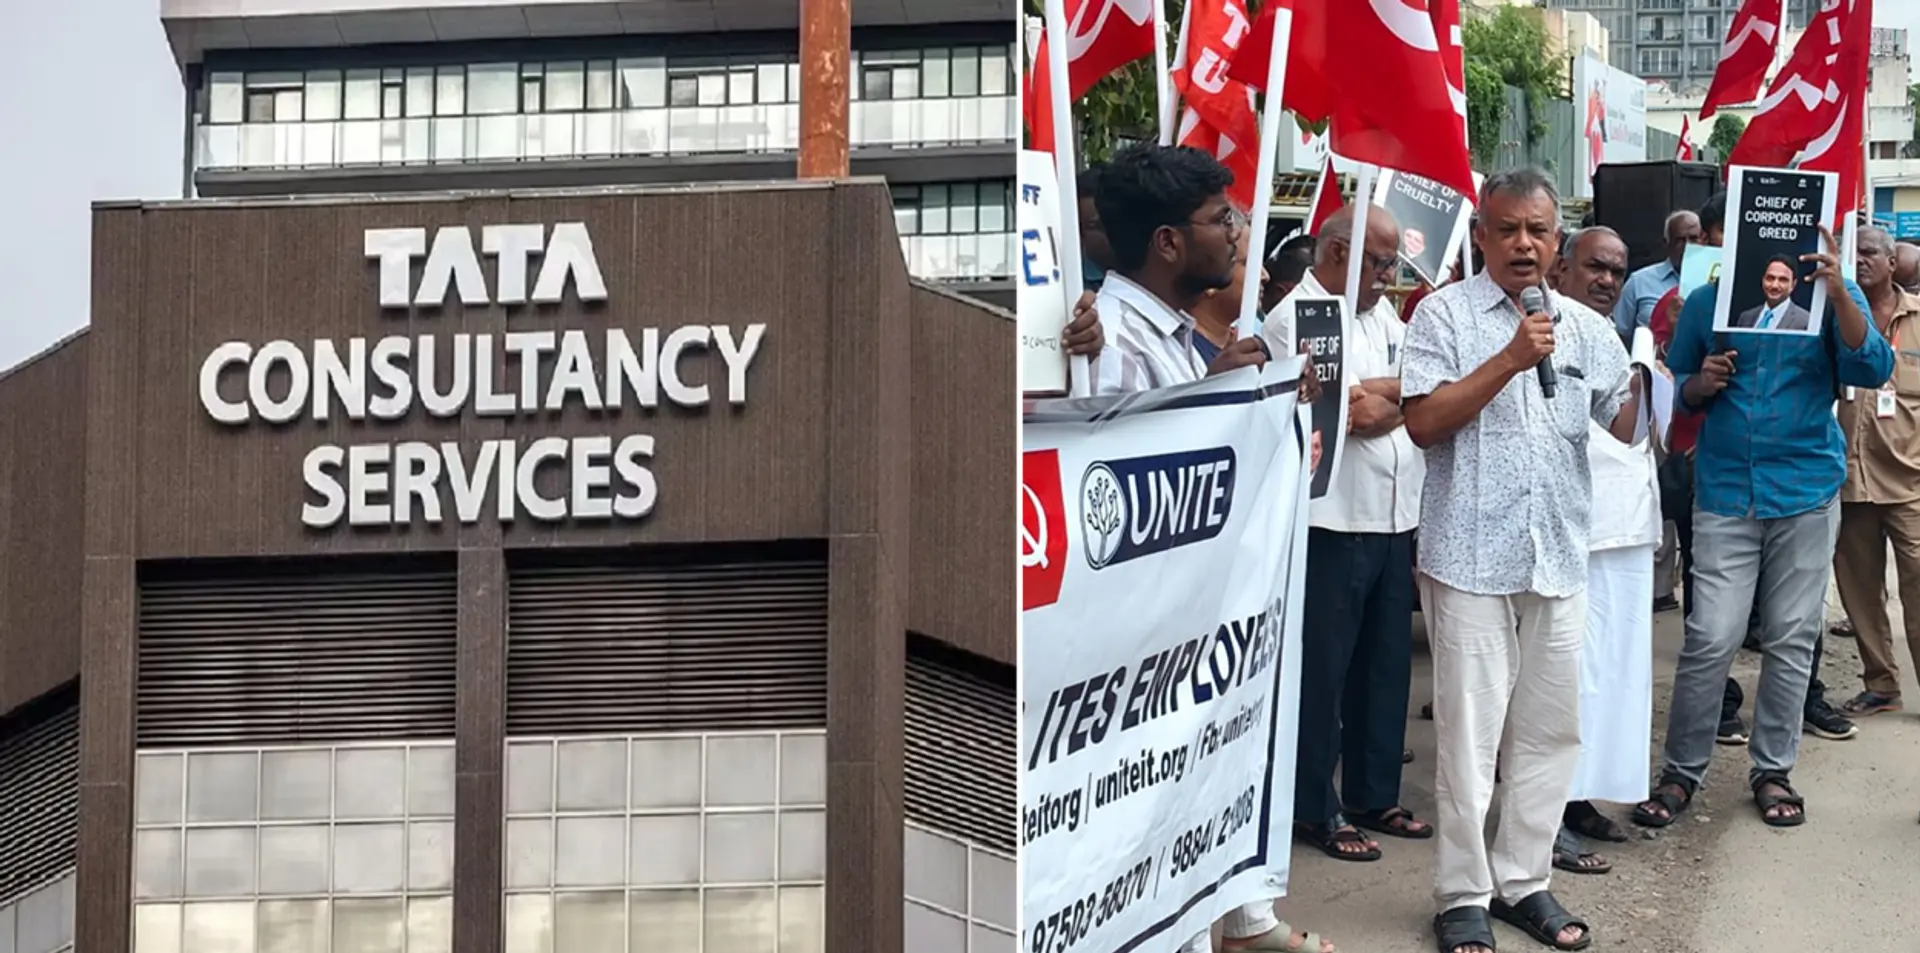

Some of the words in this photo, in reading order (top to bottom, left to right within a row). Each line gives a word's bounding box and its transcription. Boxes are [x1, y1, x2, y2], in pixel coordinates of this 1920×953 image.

[1394, 180, 1454, 213] CRUELTY
[1745, 210, 1814, 226] CORPORATE
[1755, 196, 1789, 209] CHIEF
[1790, 198, 1807, 210] OF
[364, 222, 608, 308] TATA
[1759, 226, 1797, 240] GREED
[199, 323, 767, 424] CONSULTANCY
[1328, 336, 1340, 355] OF
[301, 435, 658, 527] SERVICES
[1127, 460, 1230, 546] UNITE
[1027, 665, 1127, 772] ITES
[1095, 744, 1188, 809] uniteit.org
